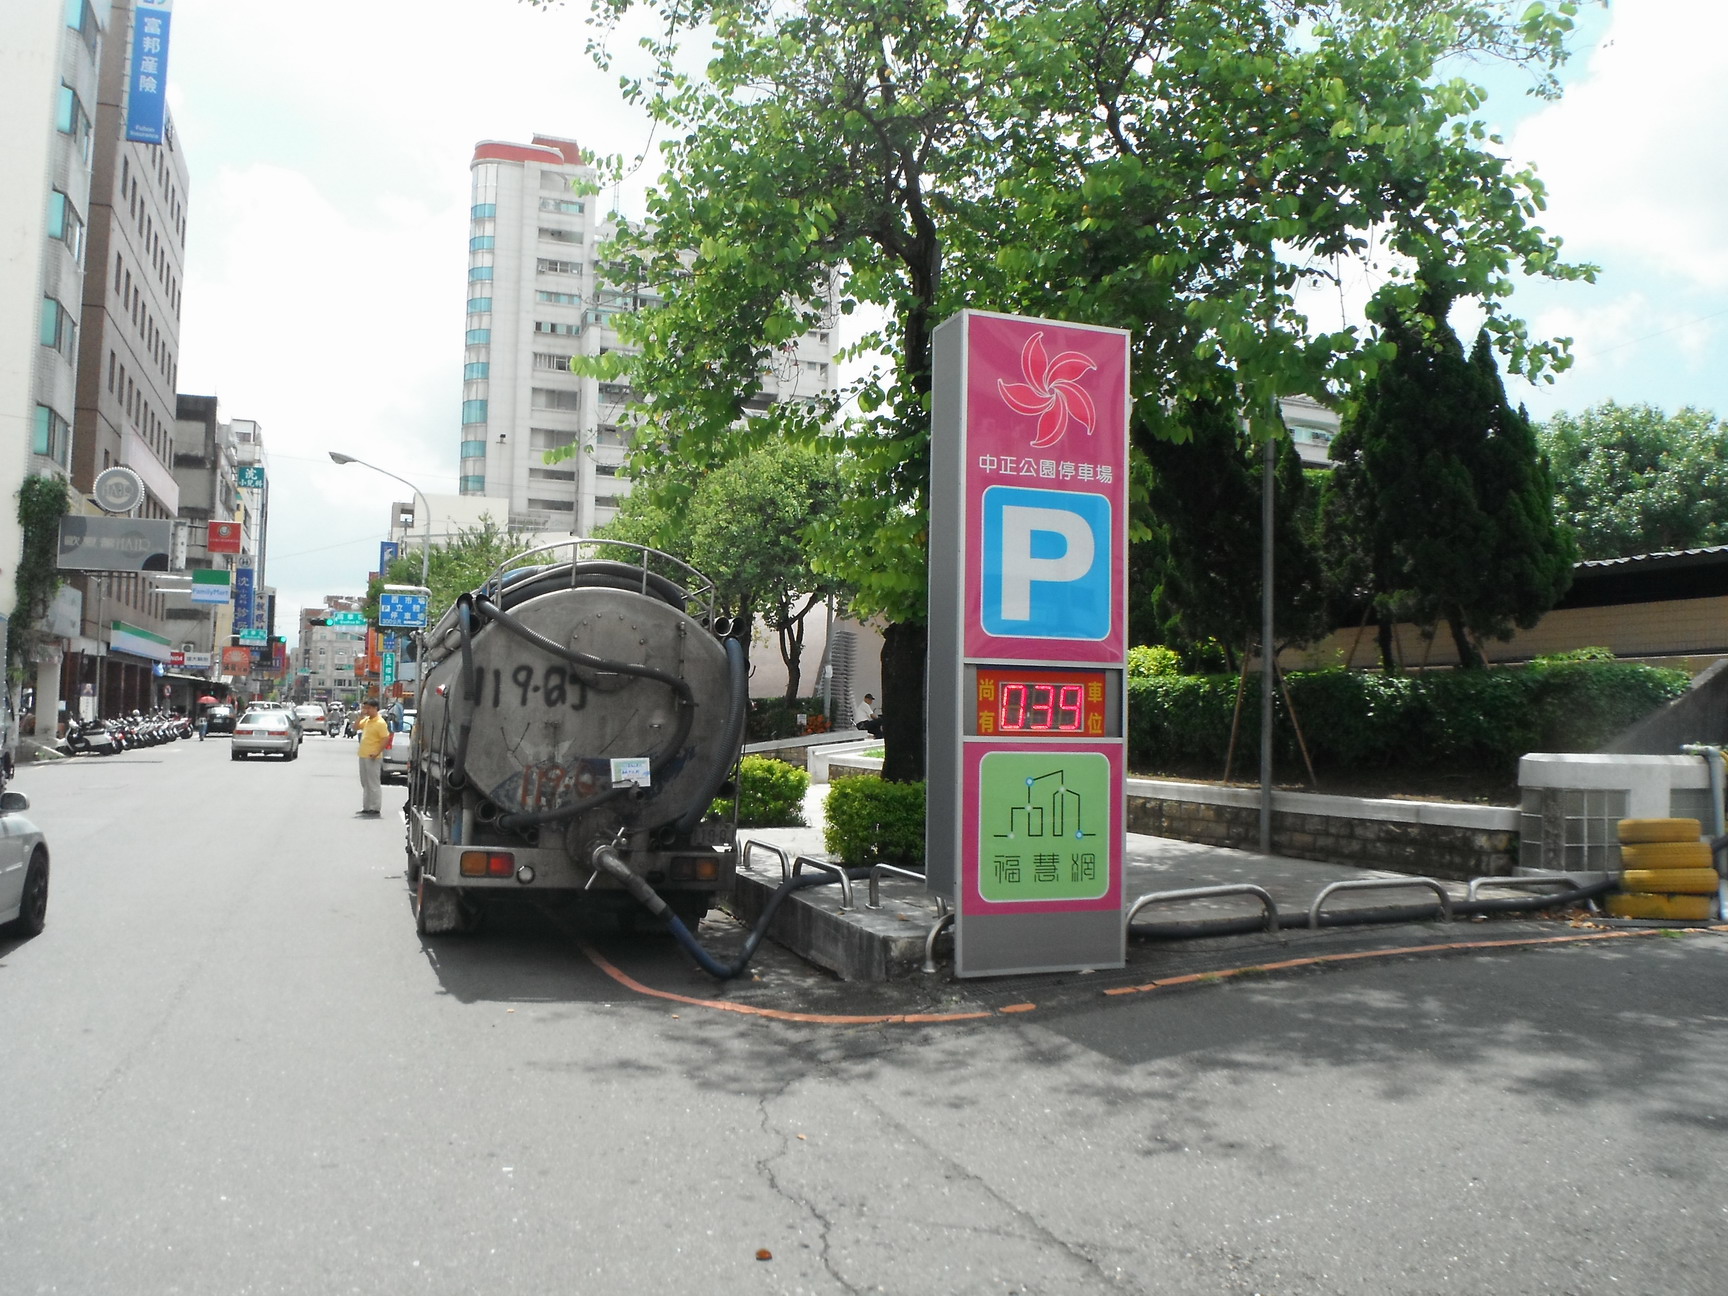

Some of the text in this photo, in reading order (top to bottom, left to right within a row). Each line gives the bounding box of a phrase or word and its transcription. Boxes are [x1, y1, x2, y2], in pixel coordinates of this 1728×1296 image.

[139, 17, 162, 94] 富邦產險
[979, 454, 1113, 484] 中正公園停車場
[1001, 504, 1096, 621] P
[192, 587, 228, 596] FamilyMart
[1001, 683, 1083, 730] 039
[993, 852, 1096, 885] 福慧網
